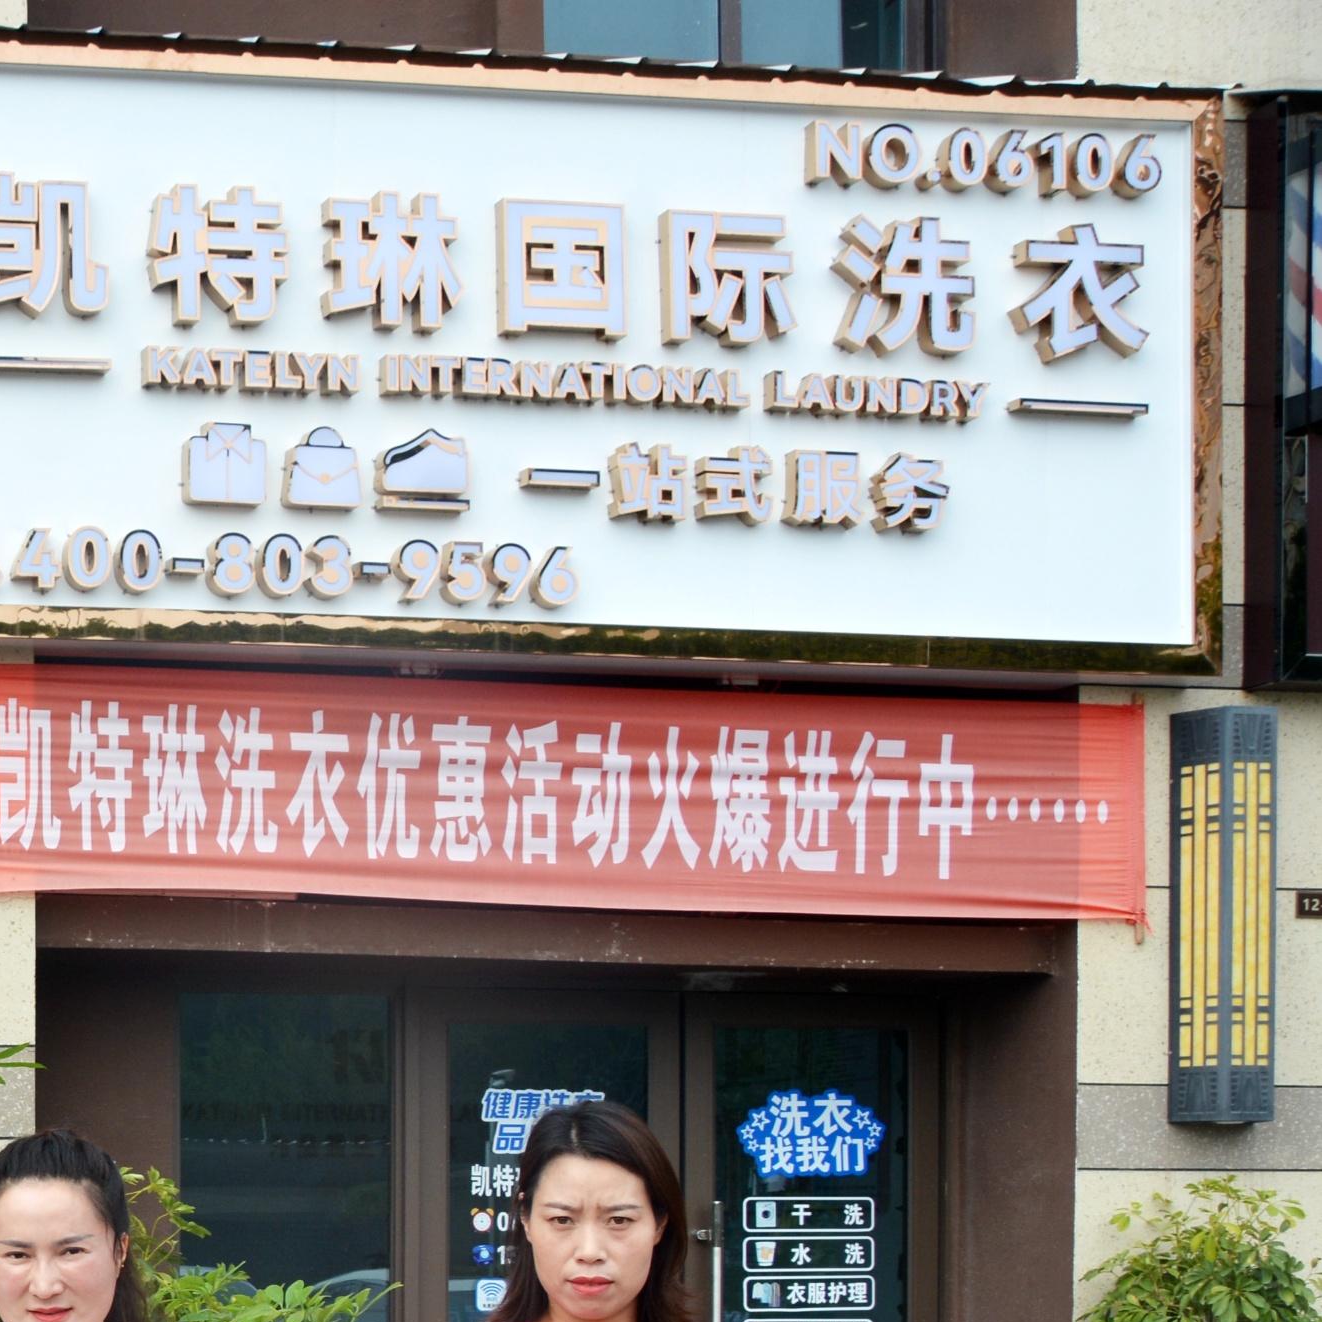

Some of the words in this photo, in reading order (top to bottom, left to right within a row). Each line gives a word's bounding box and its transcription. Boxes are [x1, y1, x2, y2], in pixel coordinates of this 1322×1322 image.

[804, 120, 1162, 200] NO.06106
[141, 345, 359, 396] KATELYN
[379, 355, 750, 411] INTERNATIONAL
[764, 369, 990, 425] LAUNDRY
[519, 442, 950, 534] 一站式服务
[11, 528, 580, 608] 400-803-9596
[769, 1092, 854, 1137] 洗衣
[470, 1164, 520, 1197] 凯特
[759, 1136, 865, 1174] 找我们
[787, 1282, 868, 1304] 衣服护理
